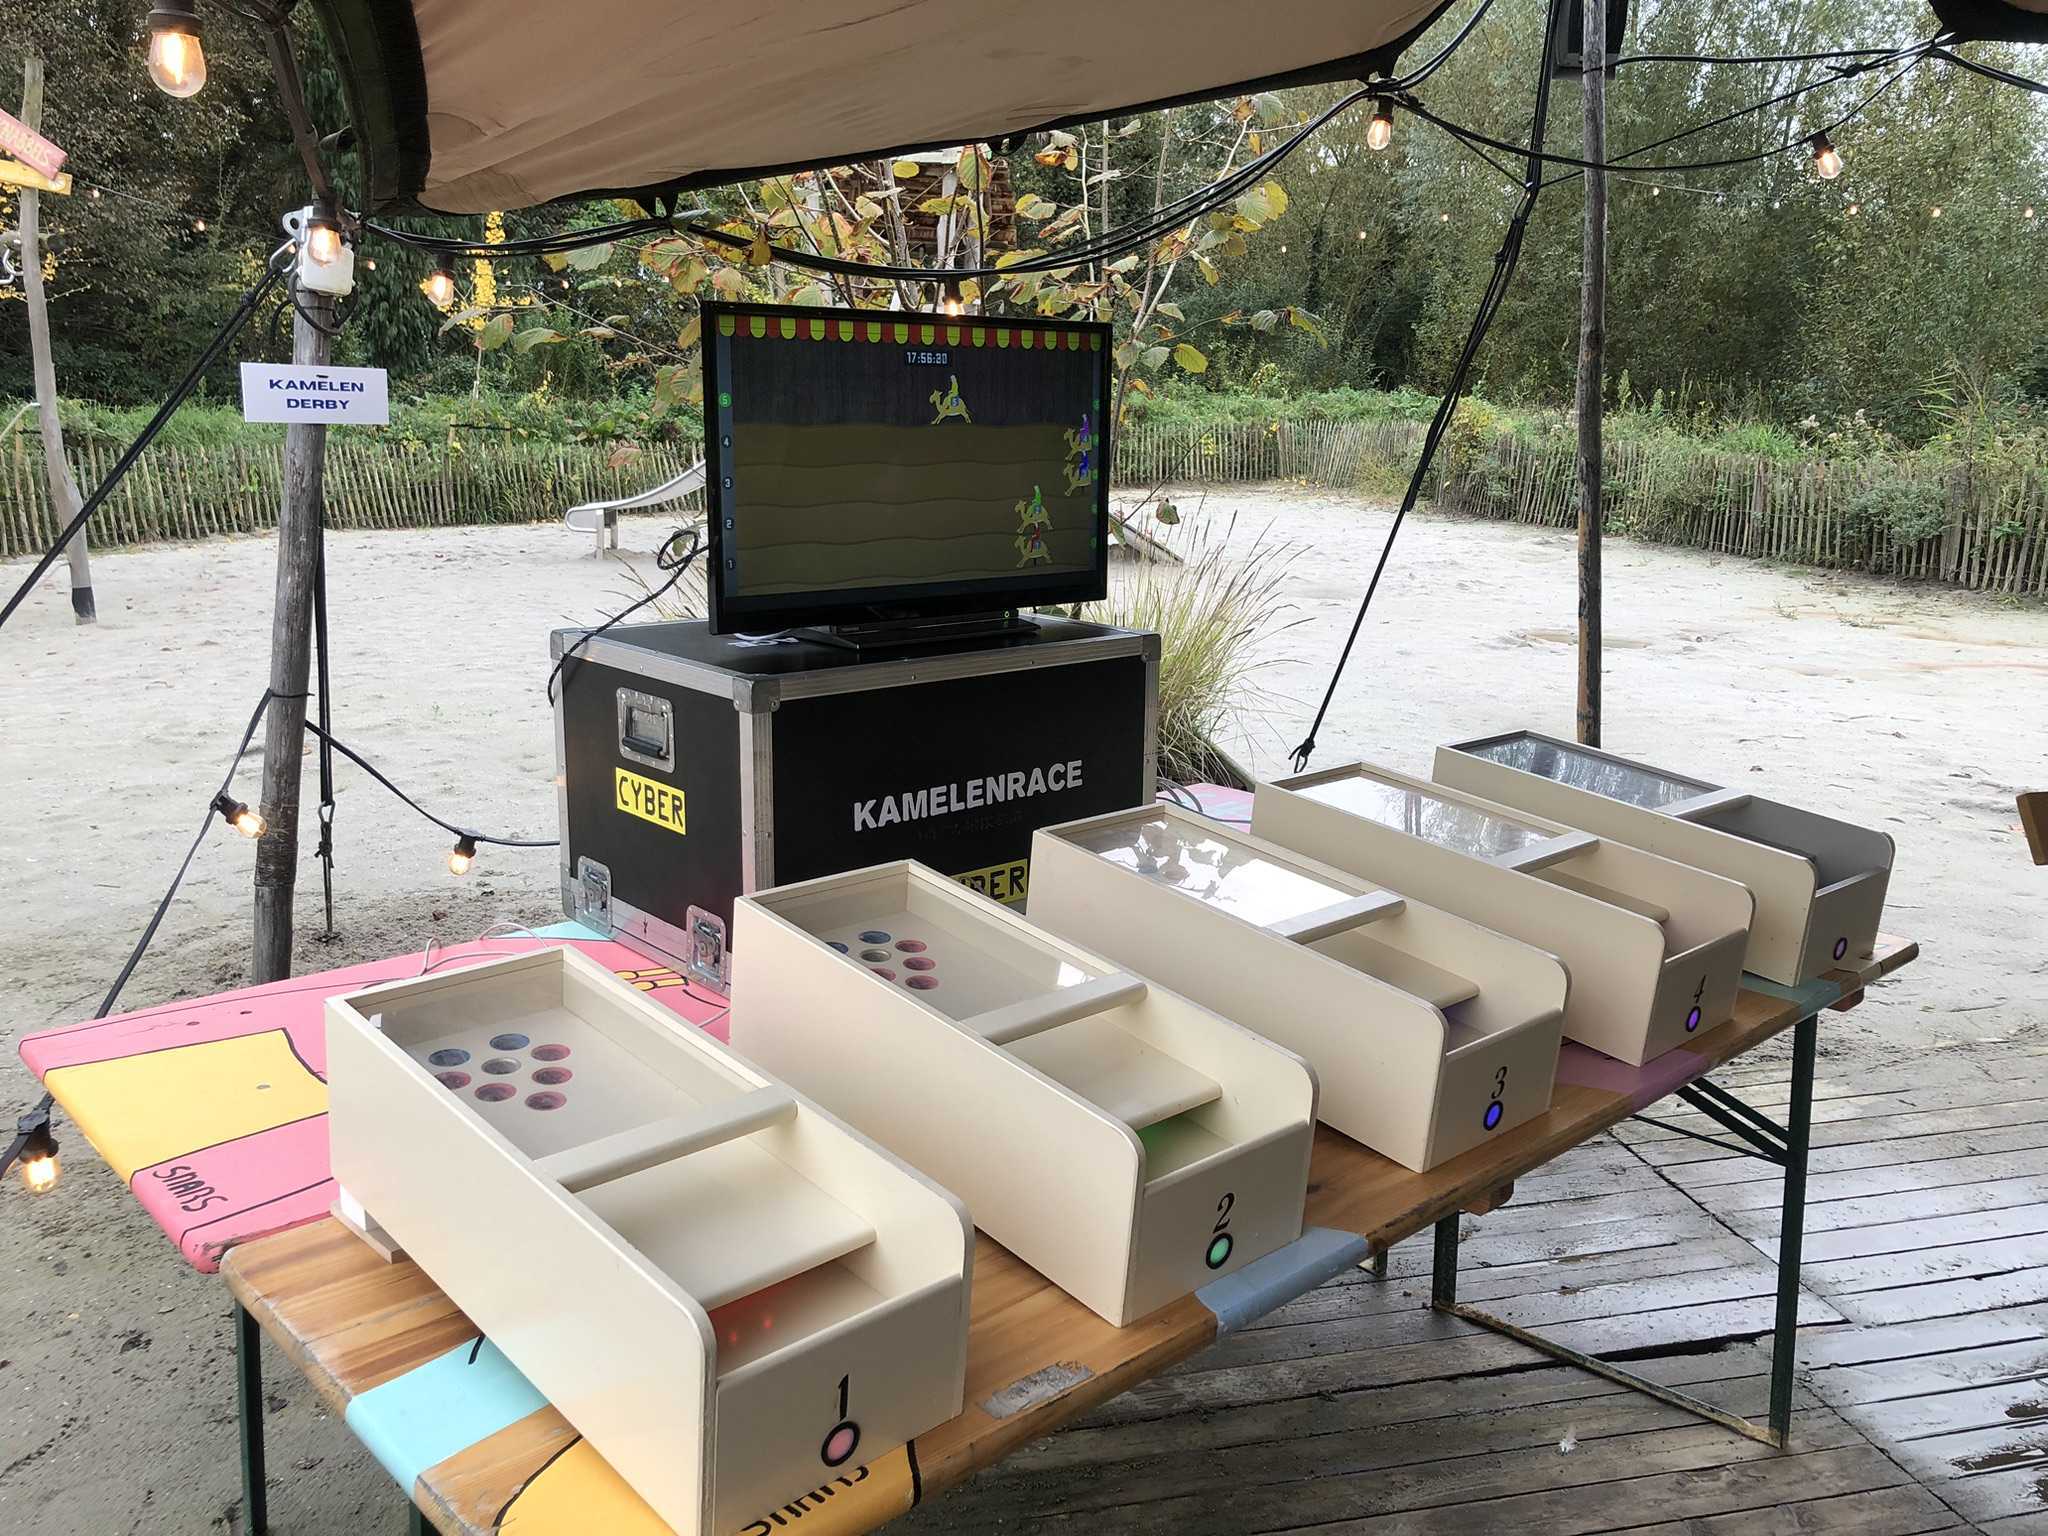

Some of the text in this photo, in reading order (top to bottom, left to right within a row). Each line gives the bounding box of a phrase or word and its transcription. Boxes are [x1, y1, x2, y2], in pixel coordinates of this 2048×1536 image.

[269, 379, 365, 393] KAMELEN
[286, 398, 350, 410] DERBY
[618, 775, 684, 828] CYBER
[853, 759, 1084, 832] KAMELENRACE
[960, 865, 1025, 900] BER
[1491, 1065, 1507, 1099] 3
[1212, 1192, 1235, 1234] 2
[838, 1374, 849, 1421] 1
